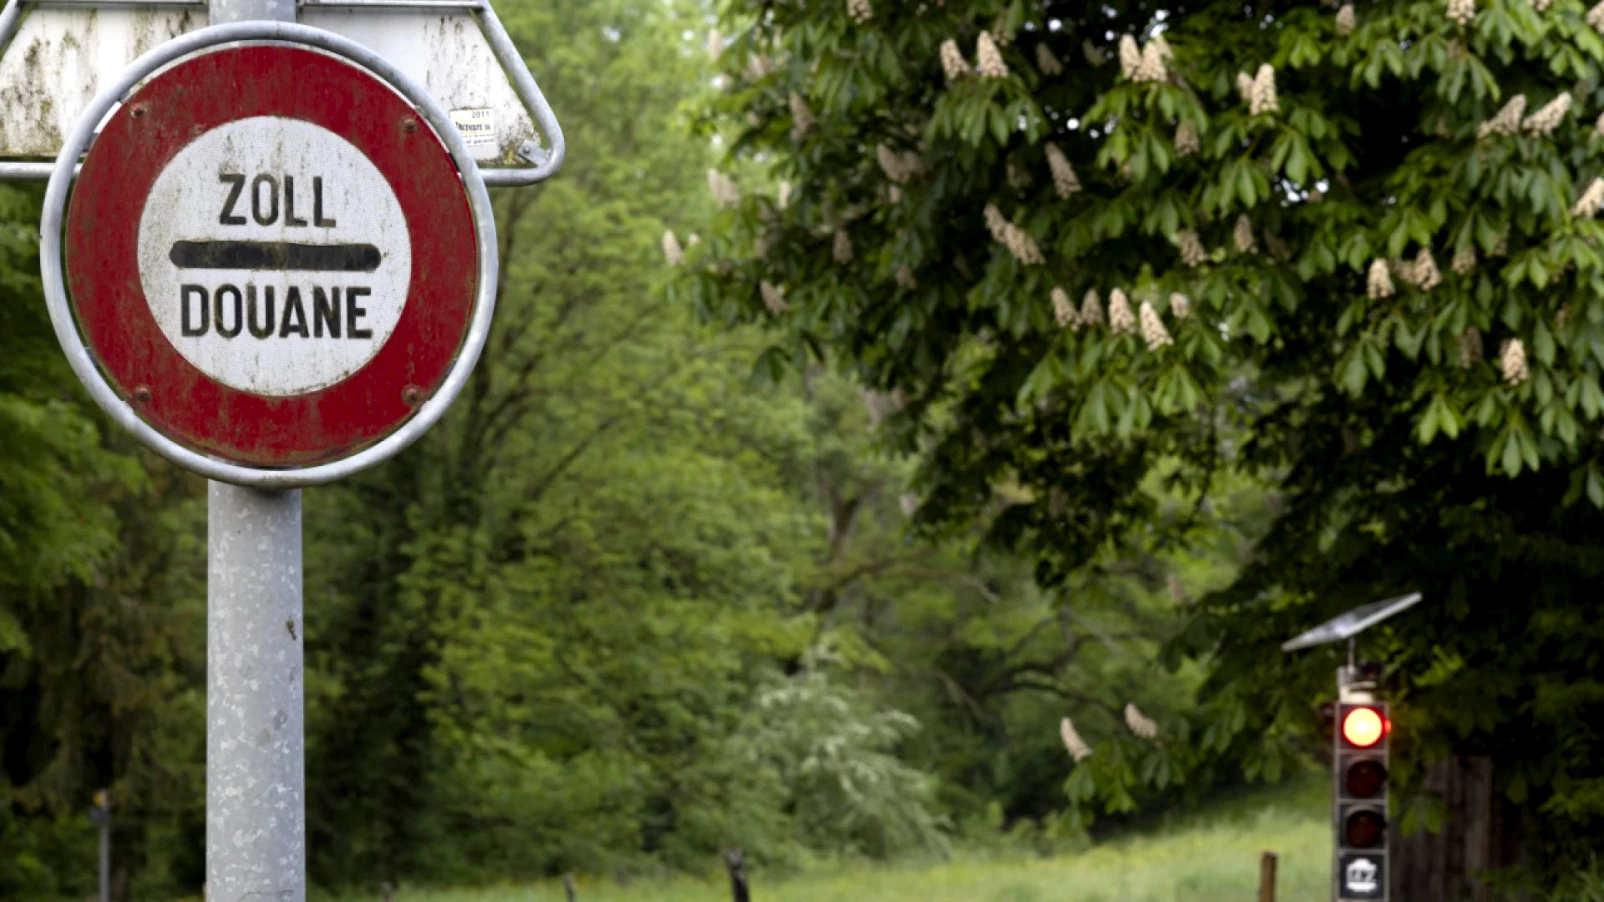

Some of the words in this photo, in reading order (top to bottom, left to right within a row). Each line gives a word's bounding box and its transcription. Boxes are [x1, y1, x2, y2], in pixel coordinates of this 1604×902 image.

[471, 110, 490, 119] 2011
[218, 173, 337, 228] ZOLL
[180, 283, 373, 340] DOUANE
